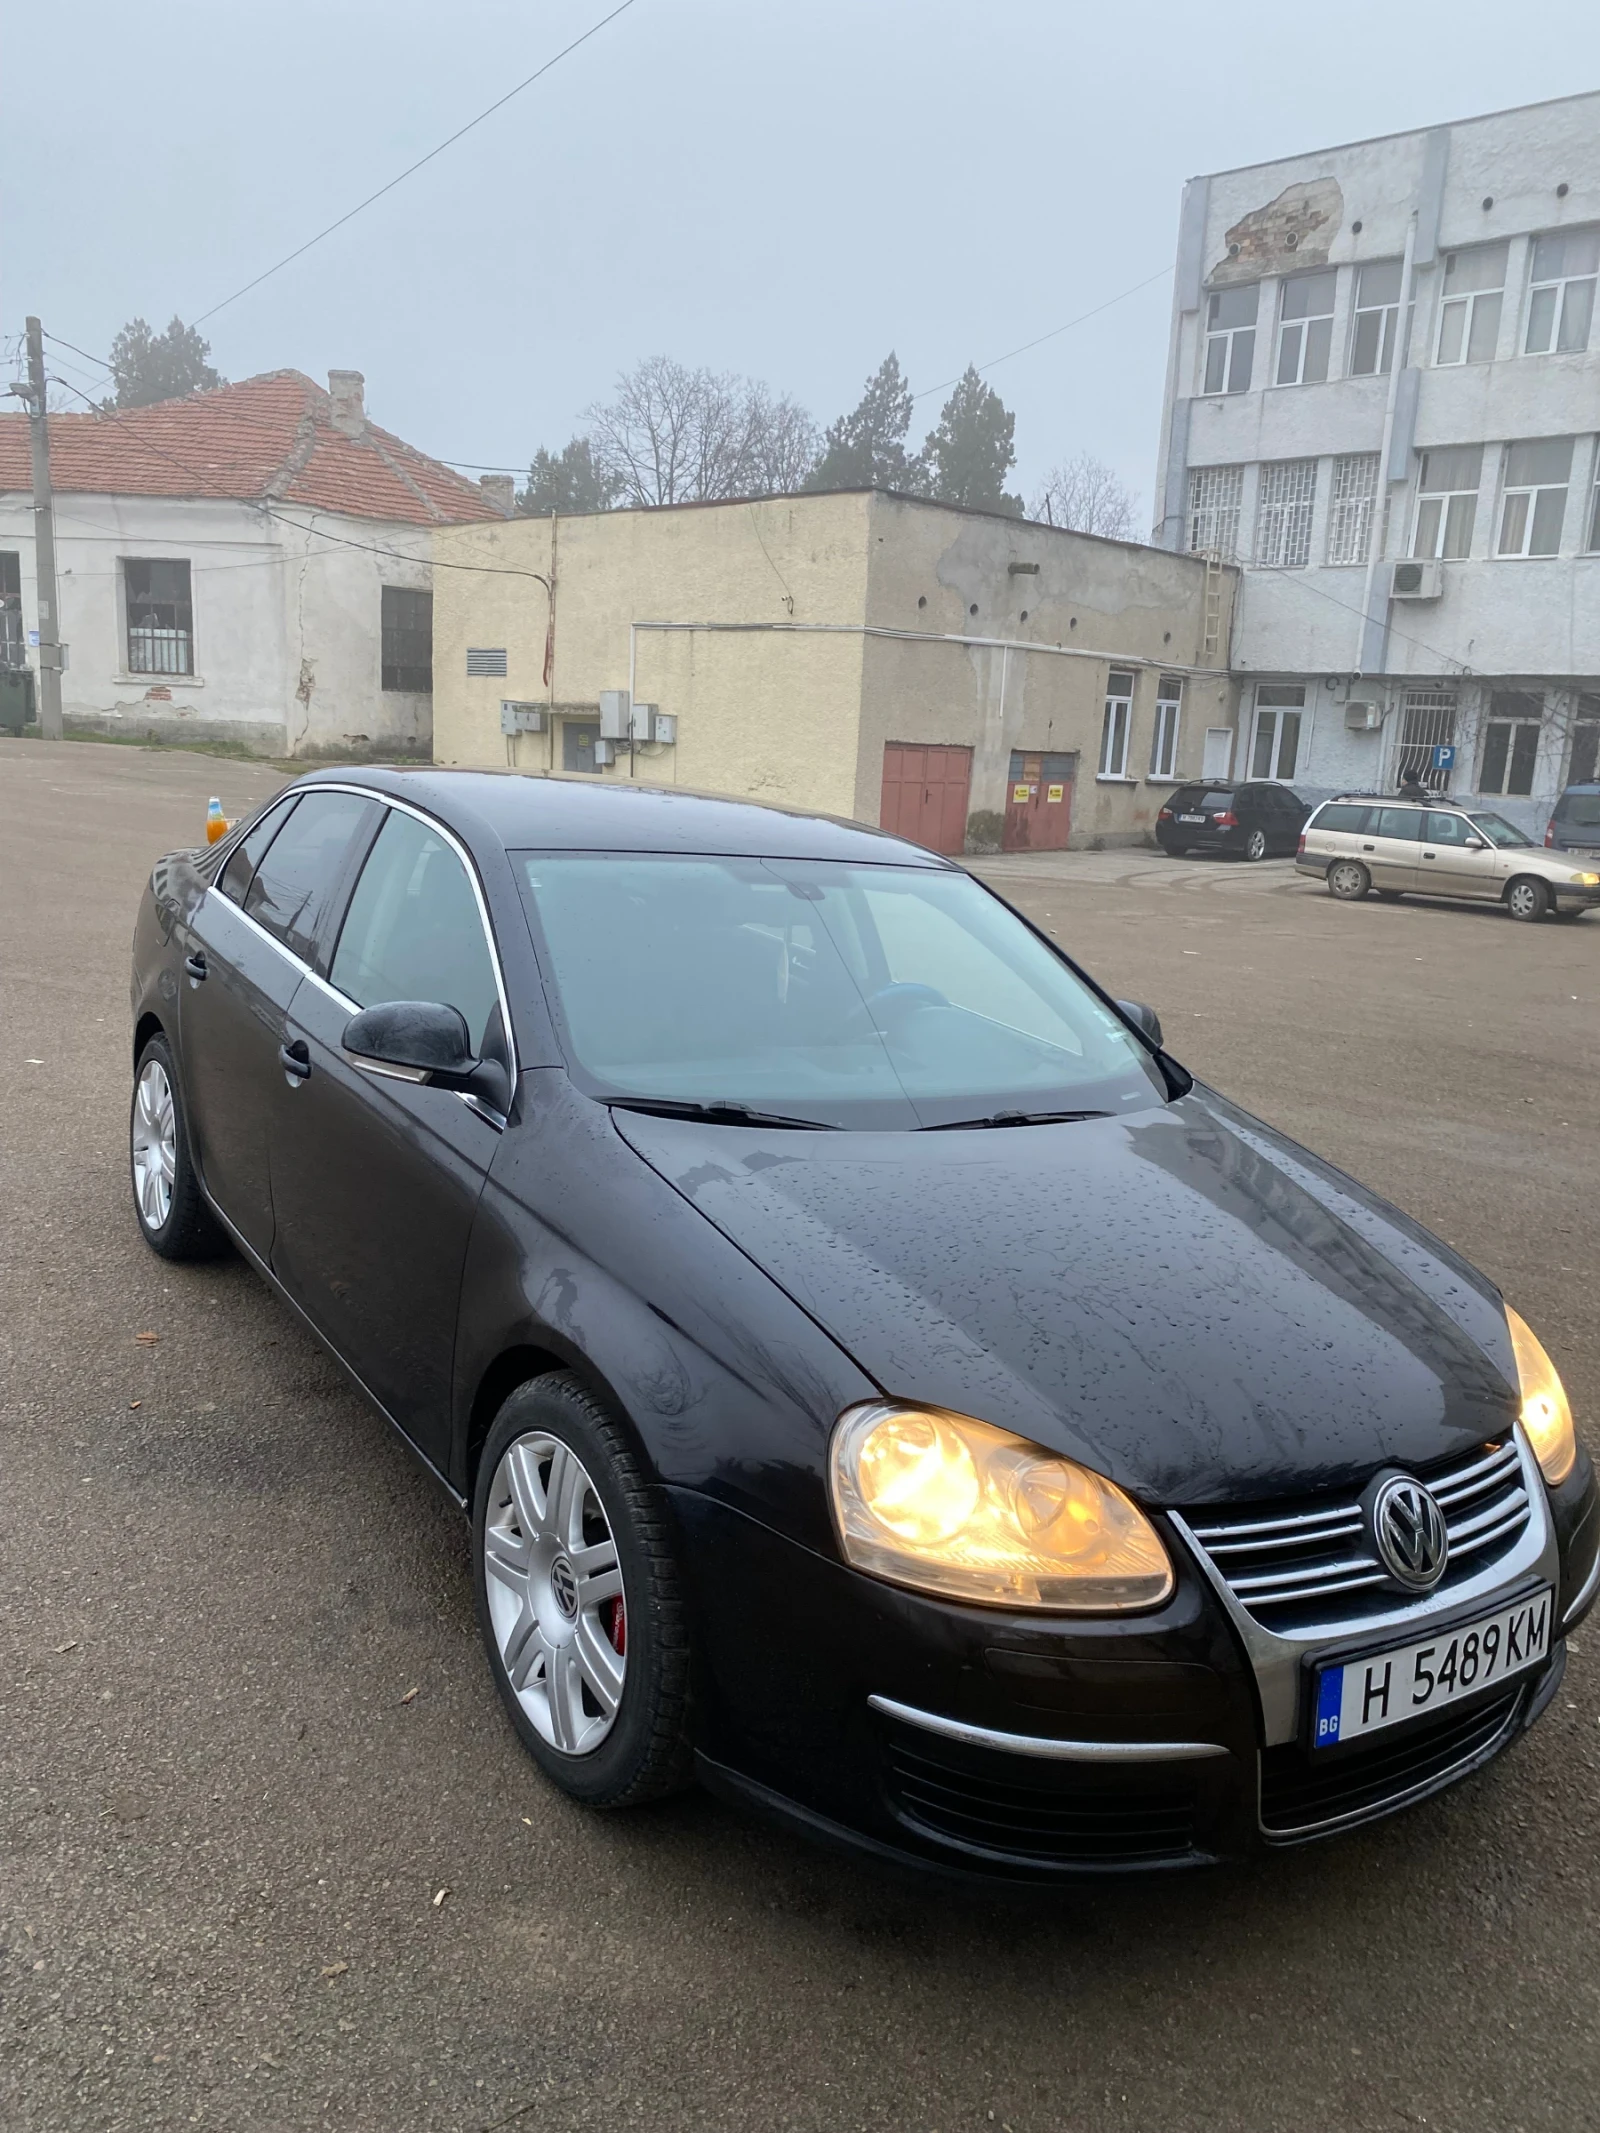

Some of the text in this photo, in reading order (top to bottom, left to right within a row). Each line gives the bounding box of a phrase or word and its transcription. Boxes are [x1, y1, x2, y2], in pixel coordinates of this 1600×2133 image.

[1438, 748, 1451, 766] P
[1361, 1660, 1392, 1724] H
[1319, 1714, 1339, 1737] BG
